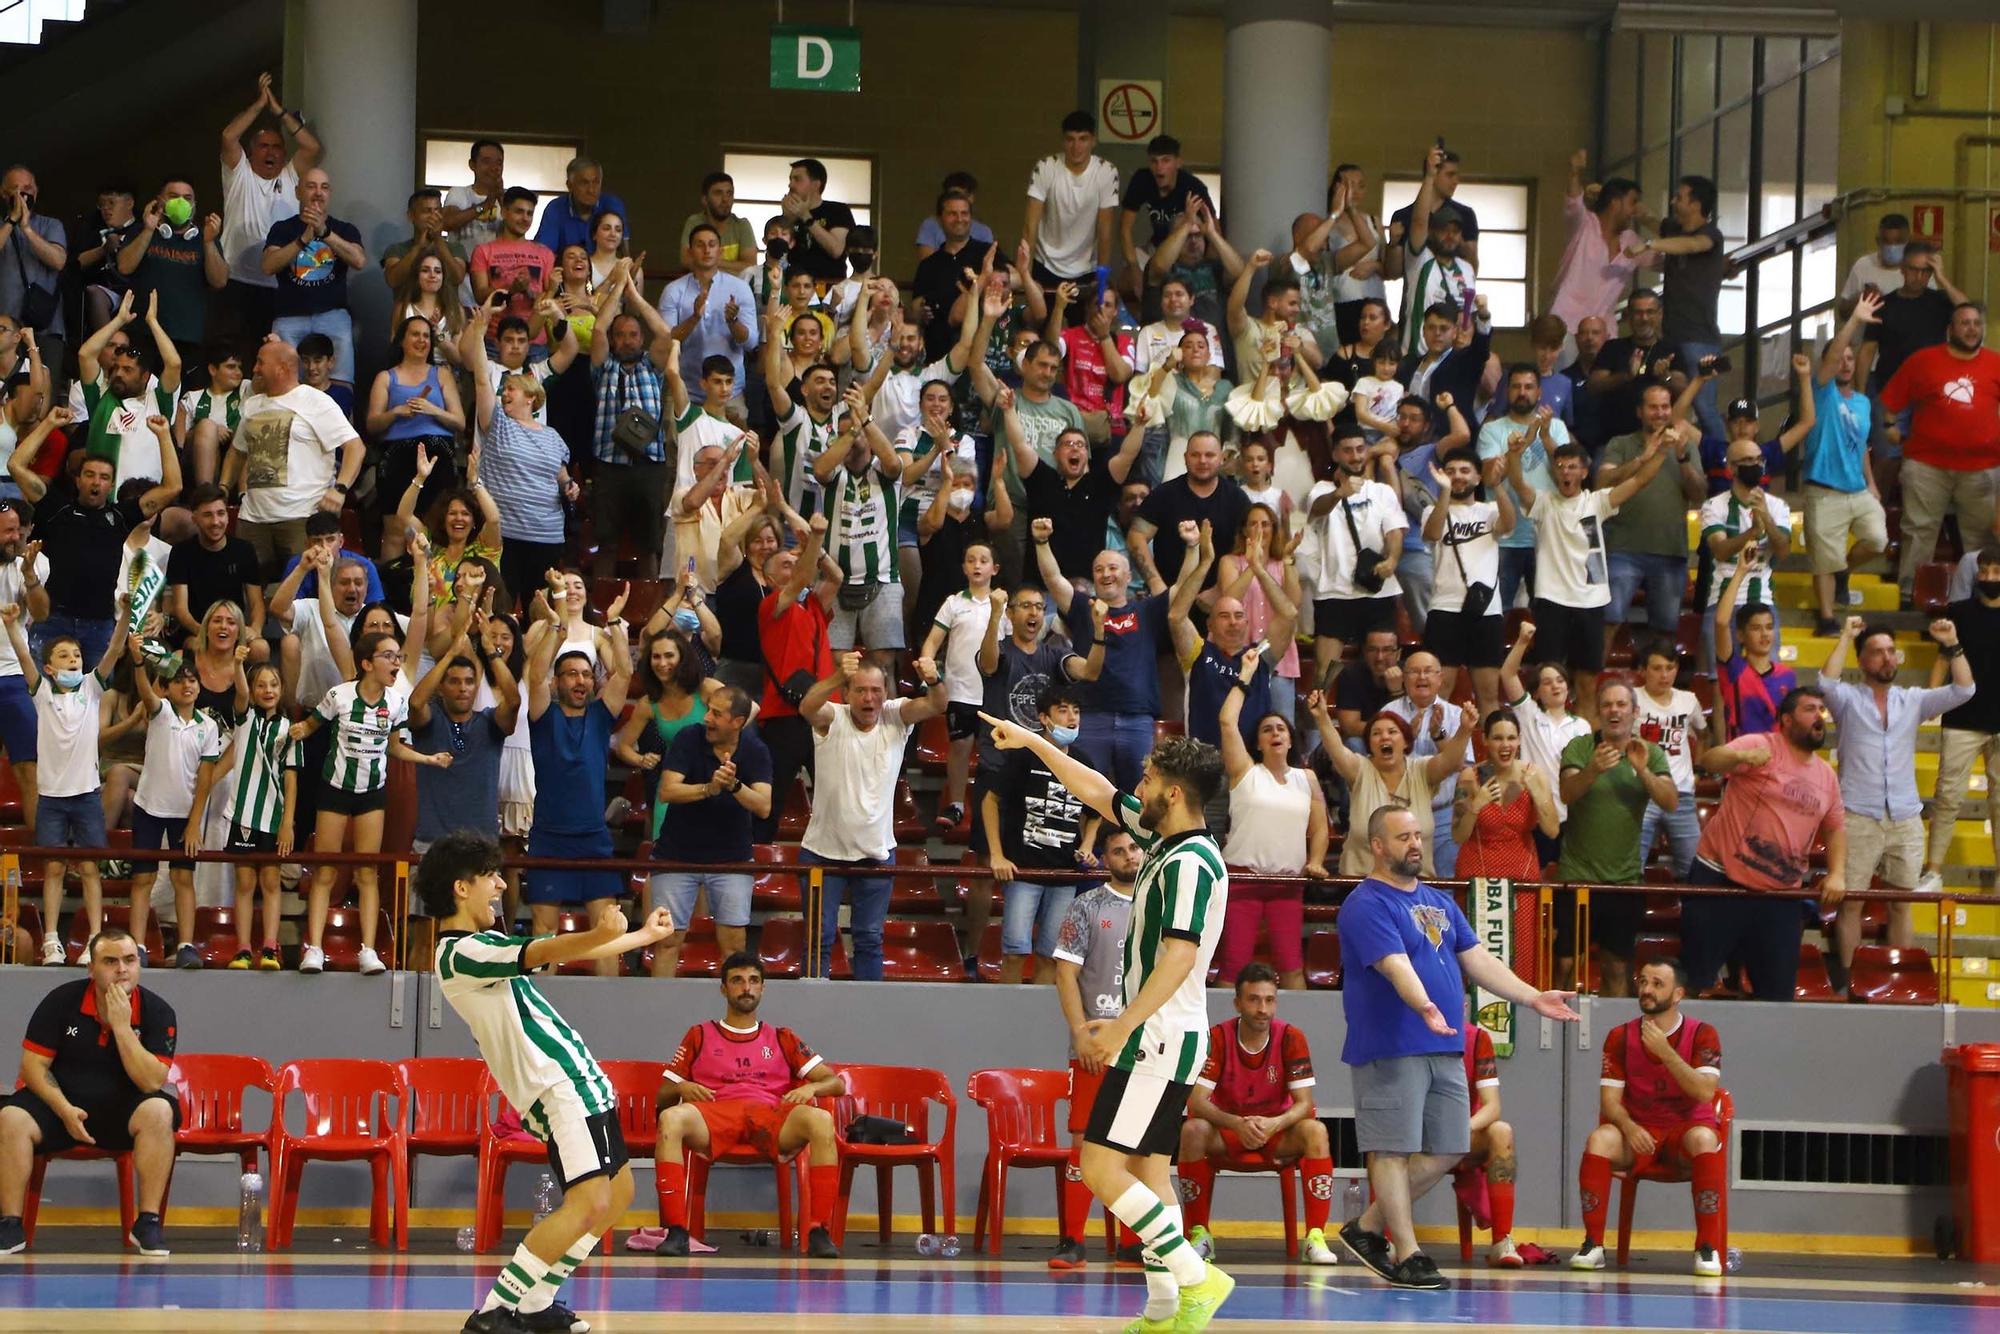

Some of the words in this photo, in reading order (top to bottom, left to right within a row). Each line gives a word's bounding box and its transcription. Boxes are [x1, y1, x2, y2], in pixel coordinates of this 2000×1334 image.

[797, 36, 833, 79] D
[1453, 520, 1487, 537] NIKE
[1009, 692, 1037, 706] PEPE
[735, 1057, 751, 1068] 14
